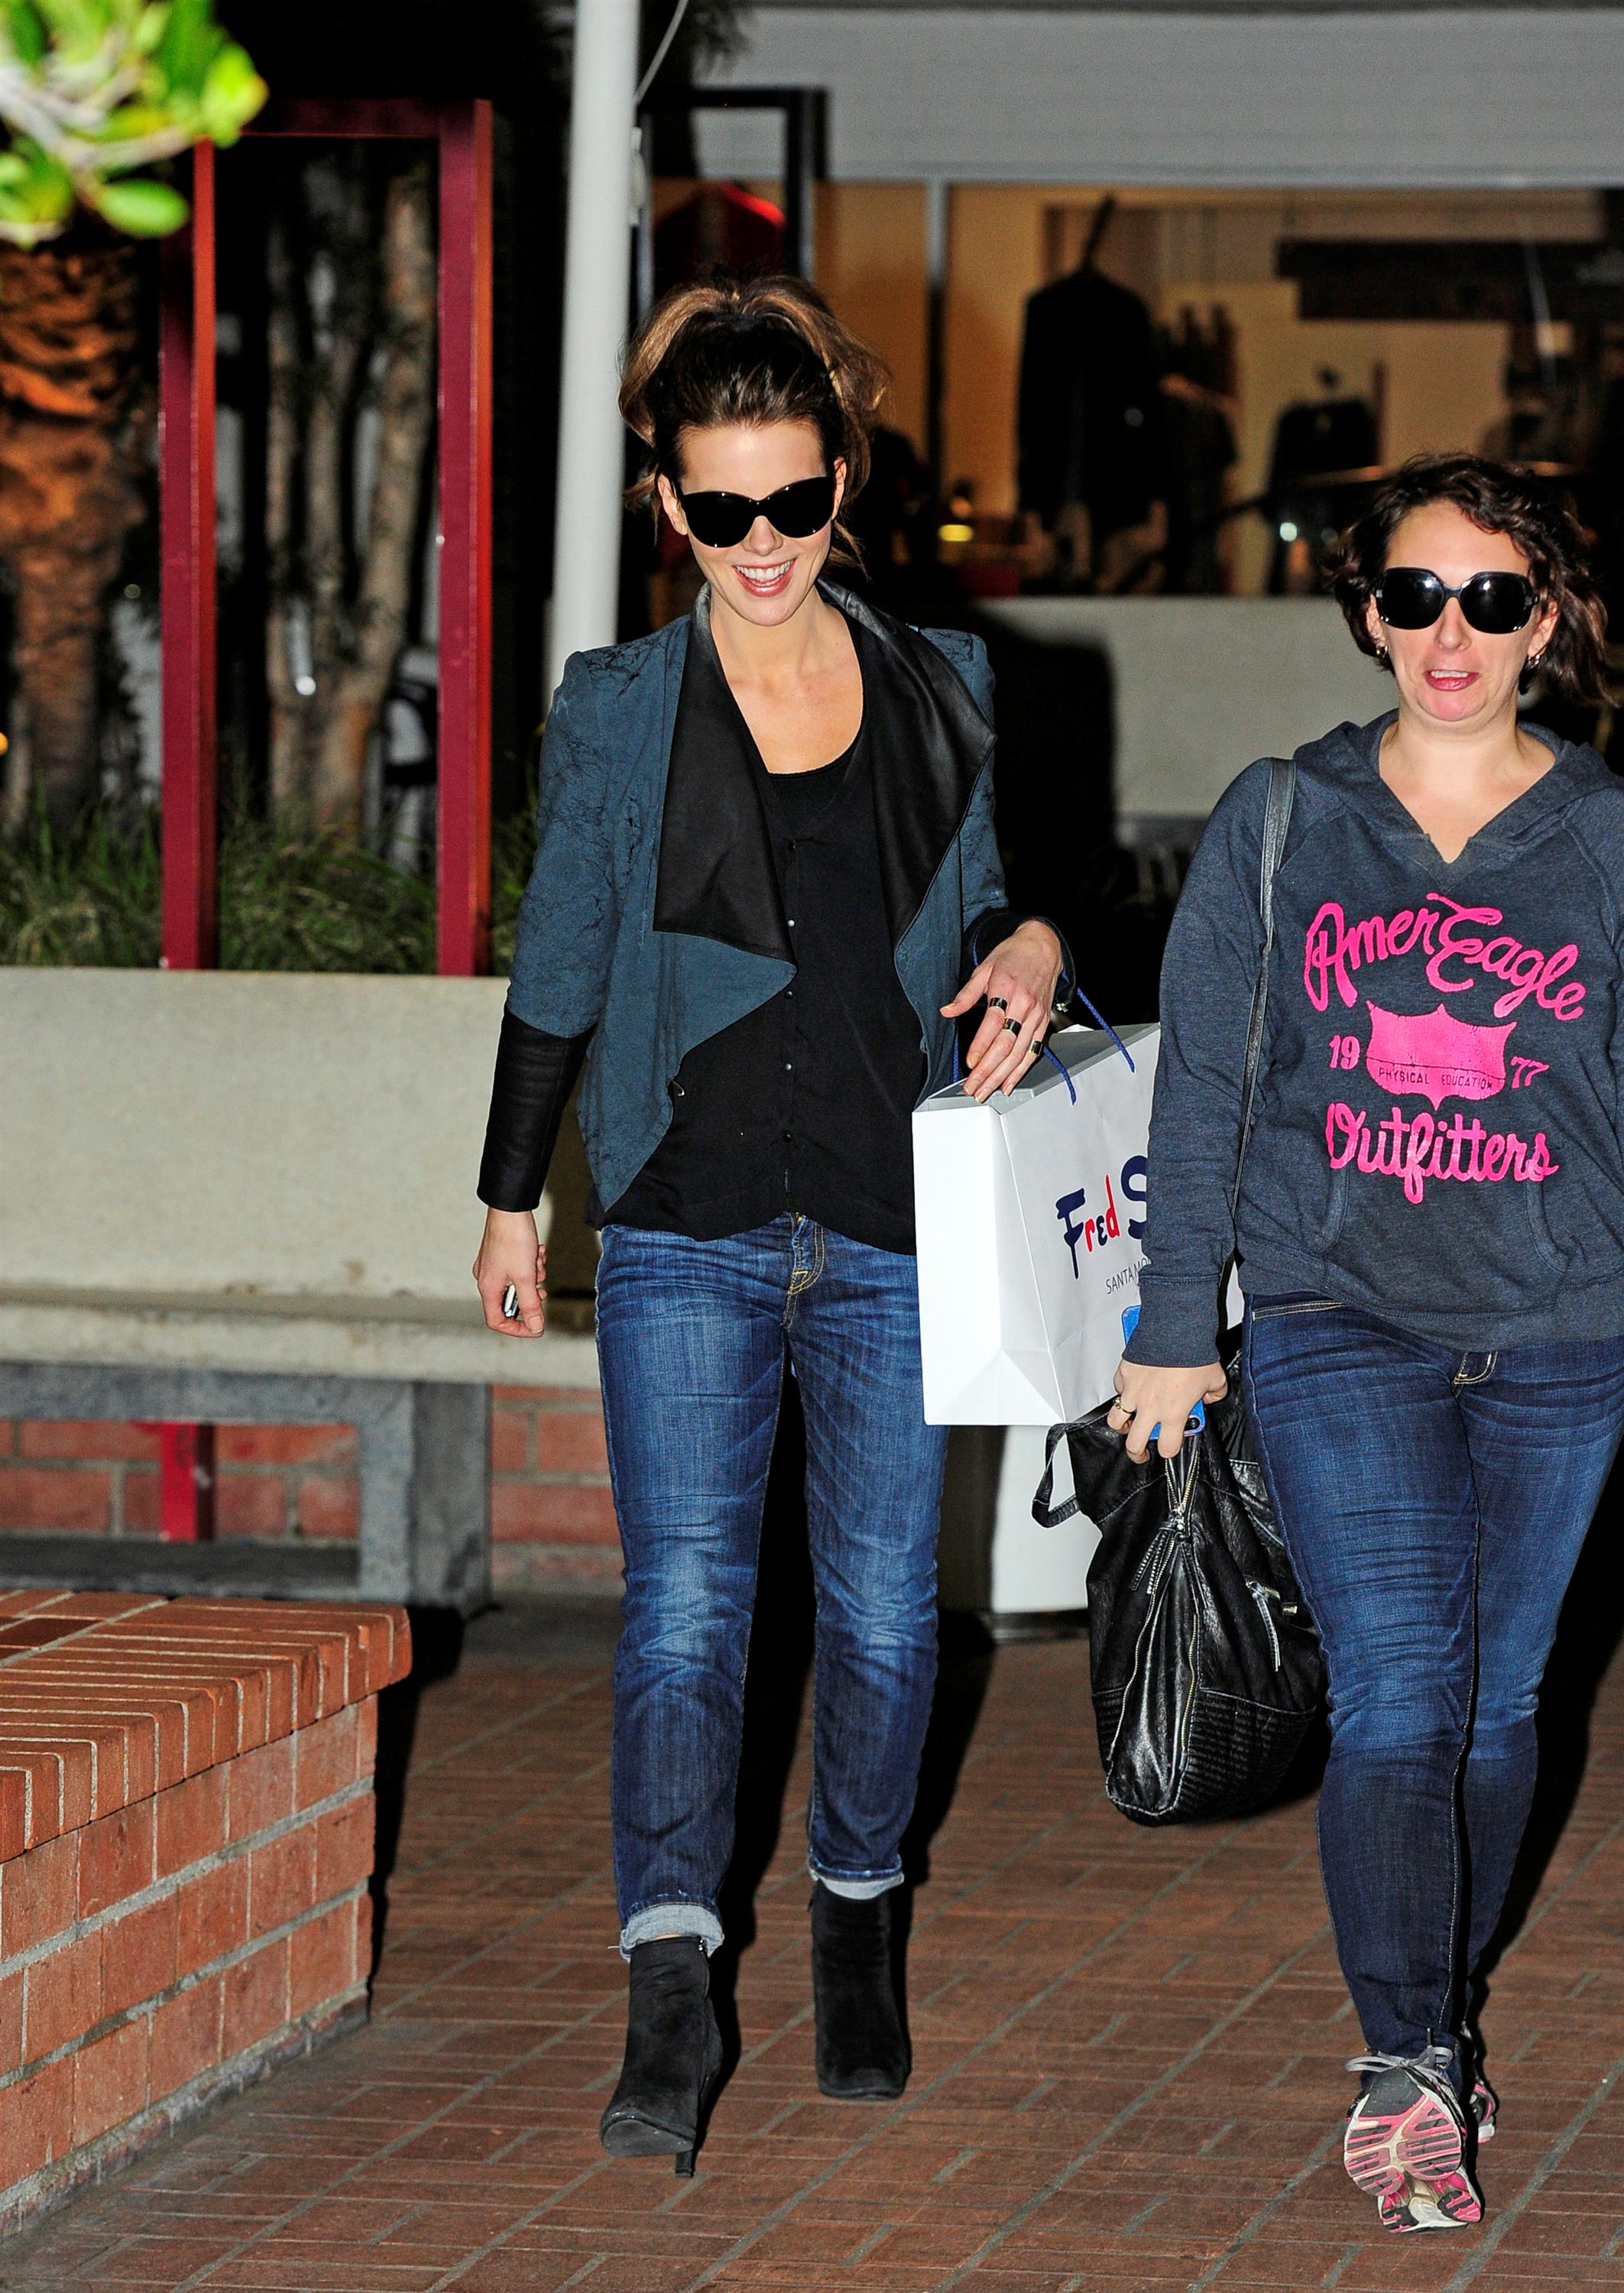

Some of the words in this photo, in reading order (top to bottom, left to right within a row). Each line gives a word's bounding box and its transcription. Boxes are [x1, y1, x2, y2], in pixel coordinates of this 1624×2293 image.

[1329, 1034, 1360, 1069] 19
[1510, 1056, 1549, 1088] 77
[1378, 1067, 1430, 1085] PHYSICAL
[1441, 1075, 1493, 1090] EDUCATION
[1326, 1102, 1559, 1204] Outfitters
[1055, 1174, 1120, 1279] Fred
[1106, 1267, 1134, 1295] SANTA
[1133, 1257, 1152, 1279] MO
